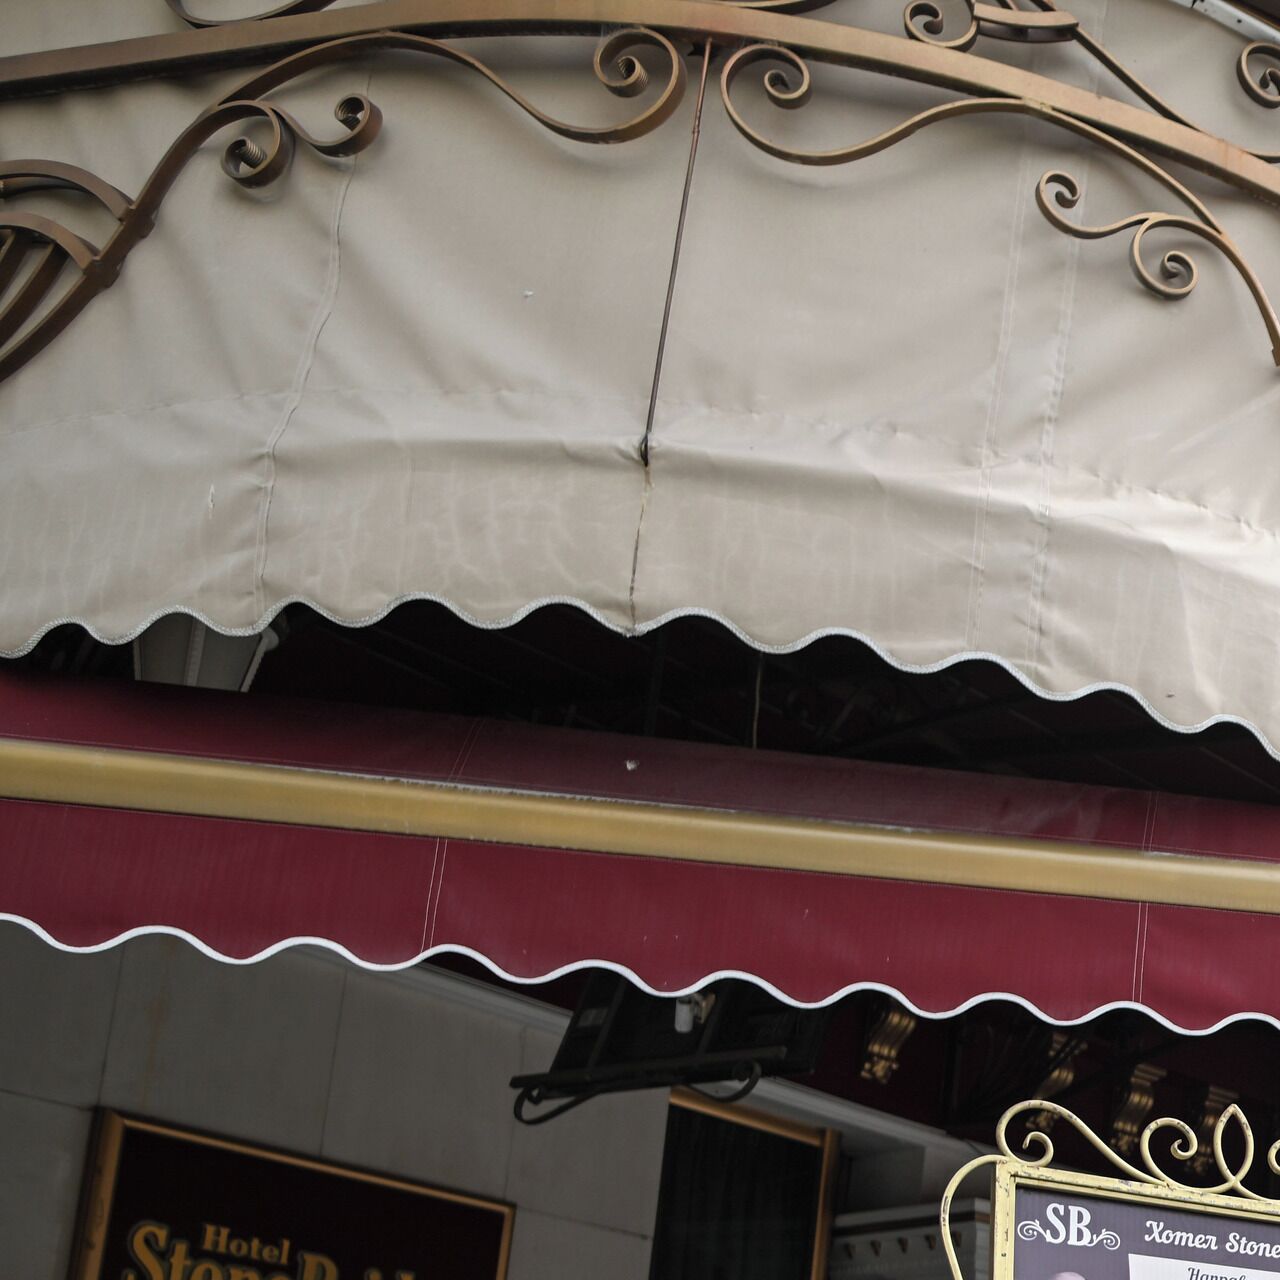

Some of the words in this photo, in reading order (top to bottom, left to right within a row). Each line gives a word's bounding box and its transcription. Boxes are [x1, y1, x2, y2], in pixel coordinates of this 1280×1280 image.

[202, 1223, 291, 1266] Hotel
[1045, 1202, 1092, 1246] SB
[1144, 1220, 1218, 1250] Хотел
